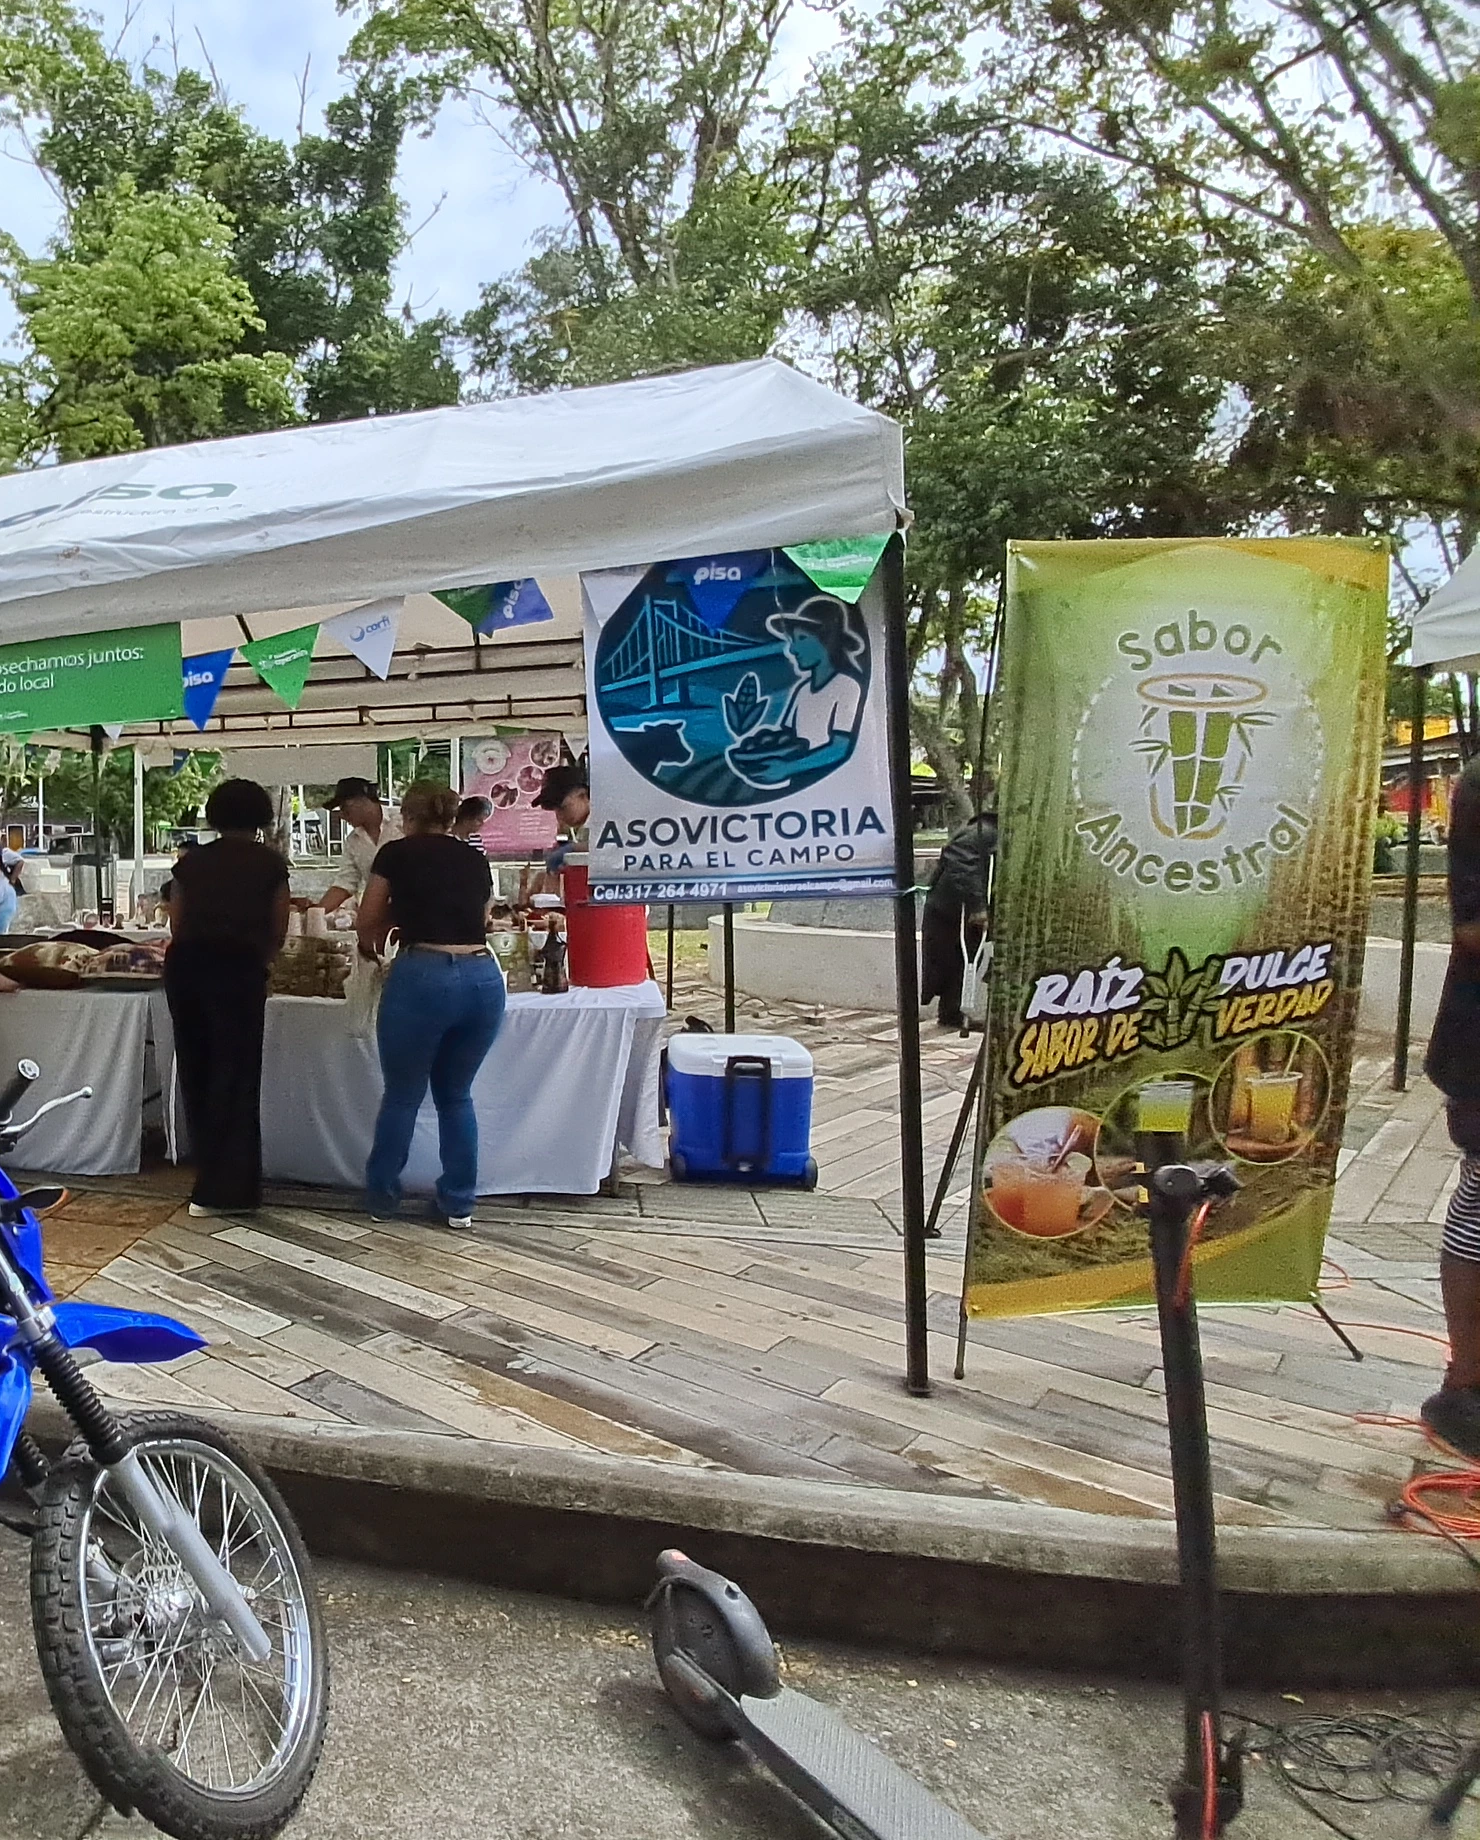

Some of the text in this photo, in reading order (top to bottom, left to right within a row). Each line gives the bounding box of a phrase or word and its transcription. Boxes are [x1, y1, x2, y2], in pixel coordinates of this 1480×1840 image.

[694, 562, 741, 585] pisa
[86, 646, 144, 669] juntos:
[1118, 609, 1283, 671] Sabor
[20, 674, 55, 692] local
[597, 806, 886, 849] ASOVICTORIA
[623, 844, 855, 872] PARA EL CAMPO
[1076, 803, 1311, 893] Ancestral
[593, 882, 728, 900] Cel:317 264 4971
[1026, 943, 1332, 1019] RAÍZ DULCE
[1015, 980, 1335, 1083] SABOR DE VERDAD
